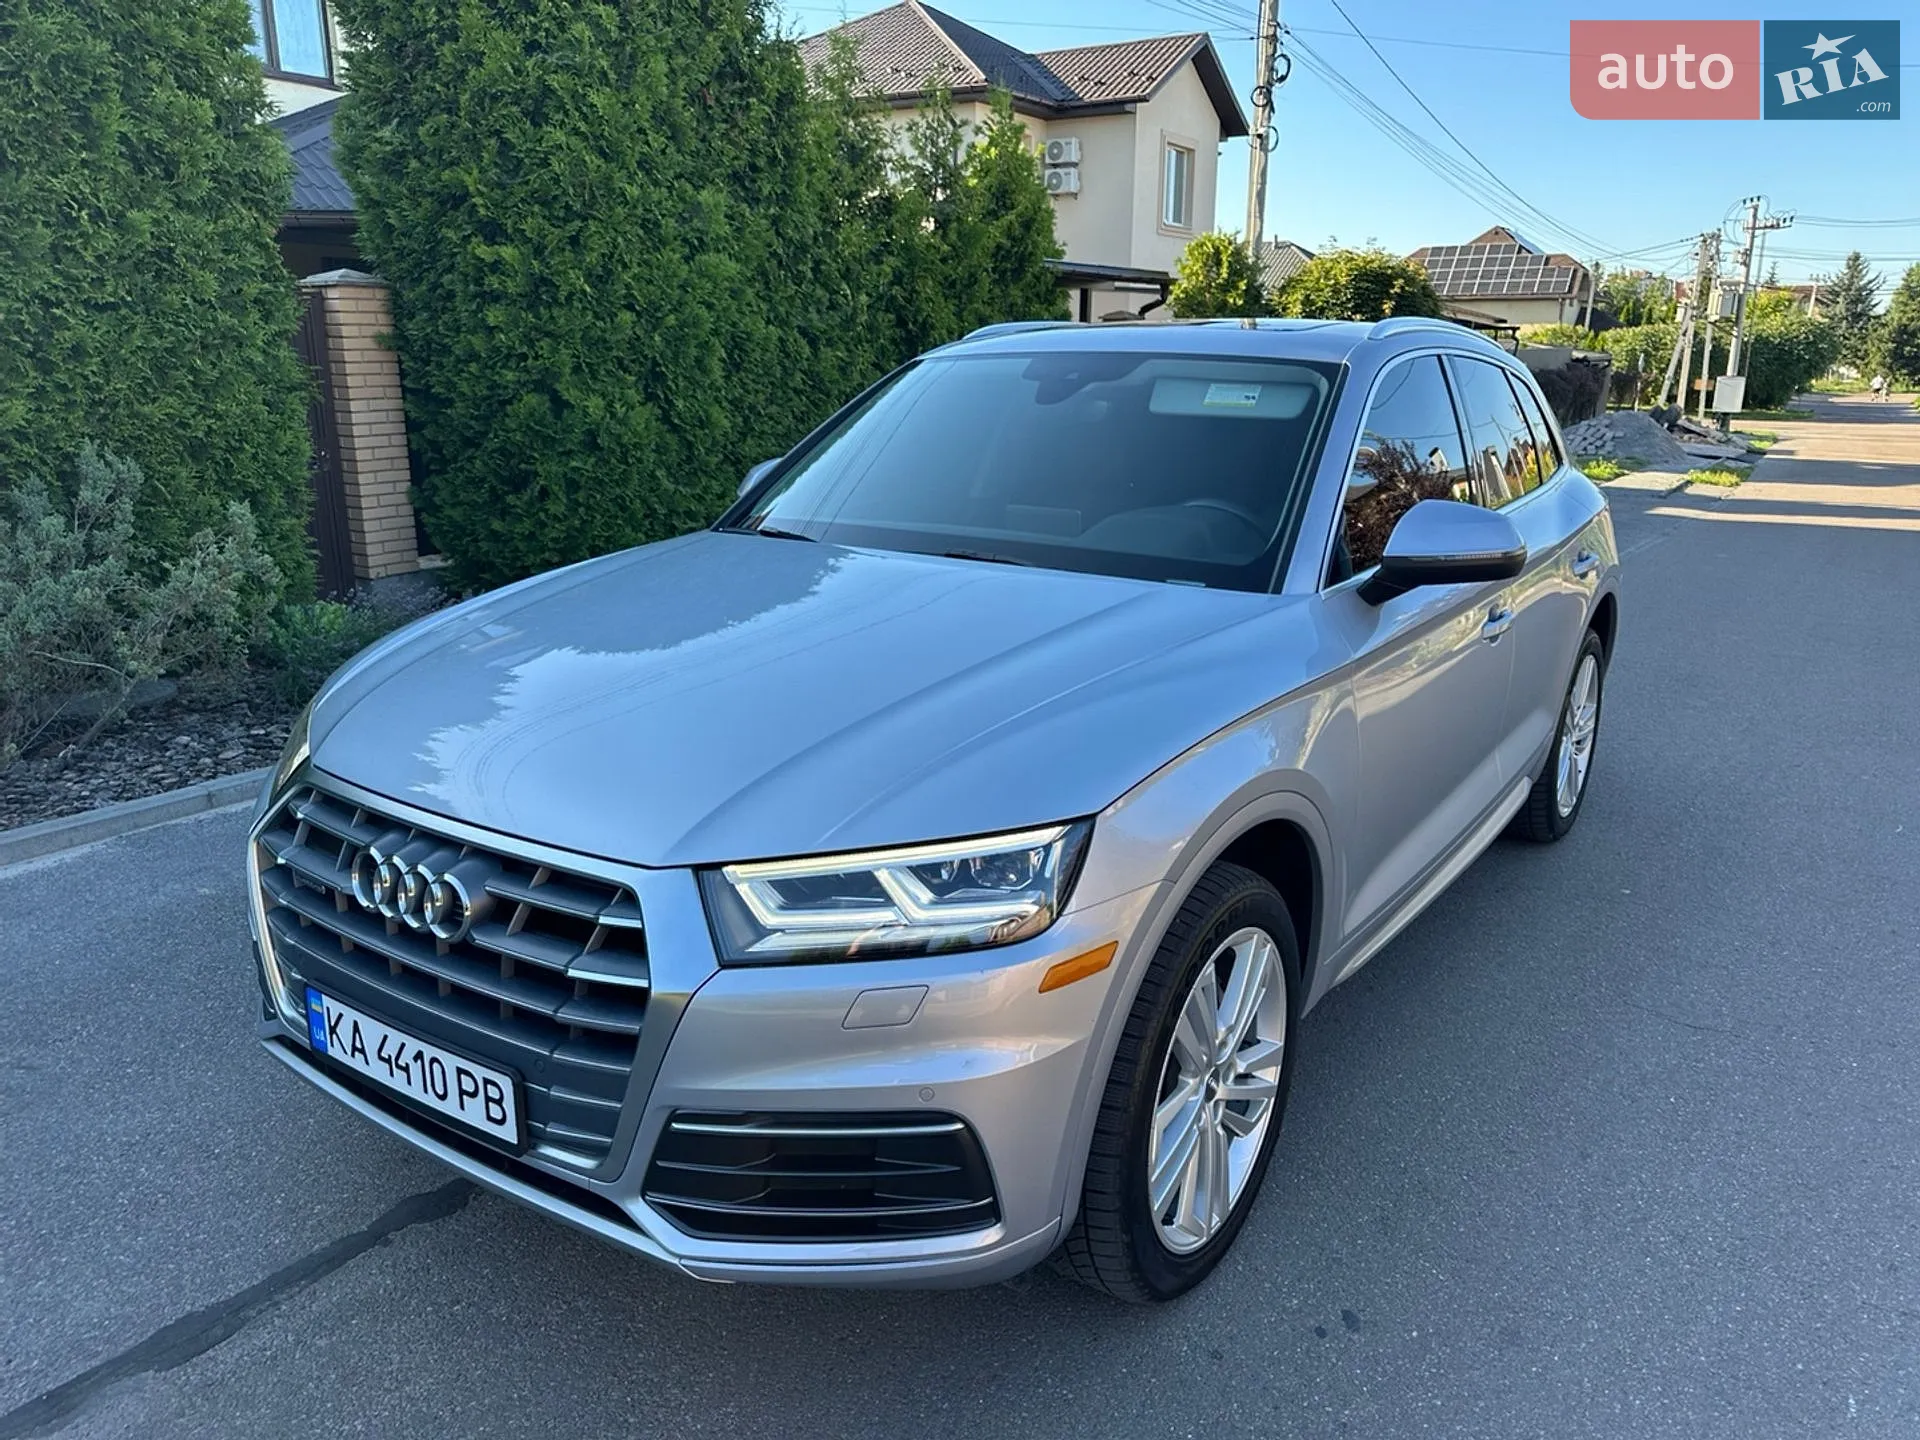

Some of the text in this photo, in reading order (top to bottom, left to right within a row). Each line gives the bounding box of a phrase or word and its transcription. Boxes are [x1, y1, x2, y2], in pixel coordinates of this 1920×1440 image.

[326, 1006, 507, 1126] KA 4410 PB
